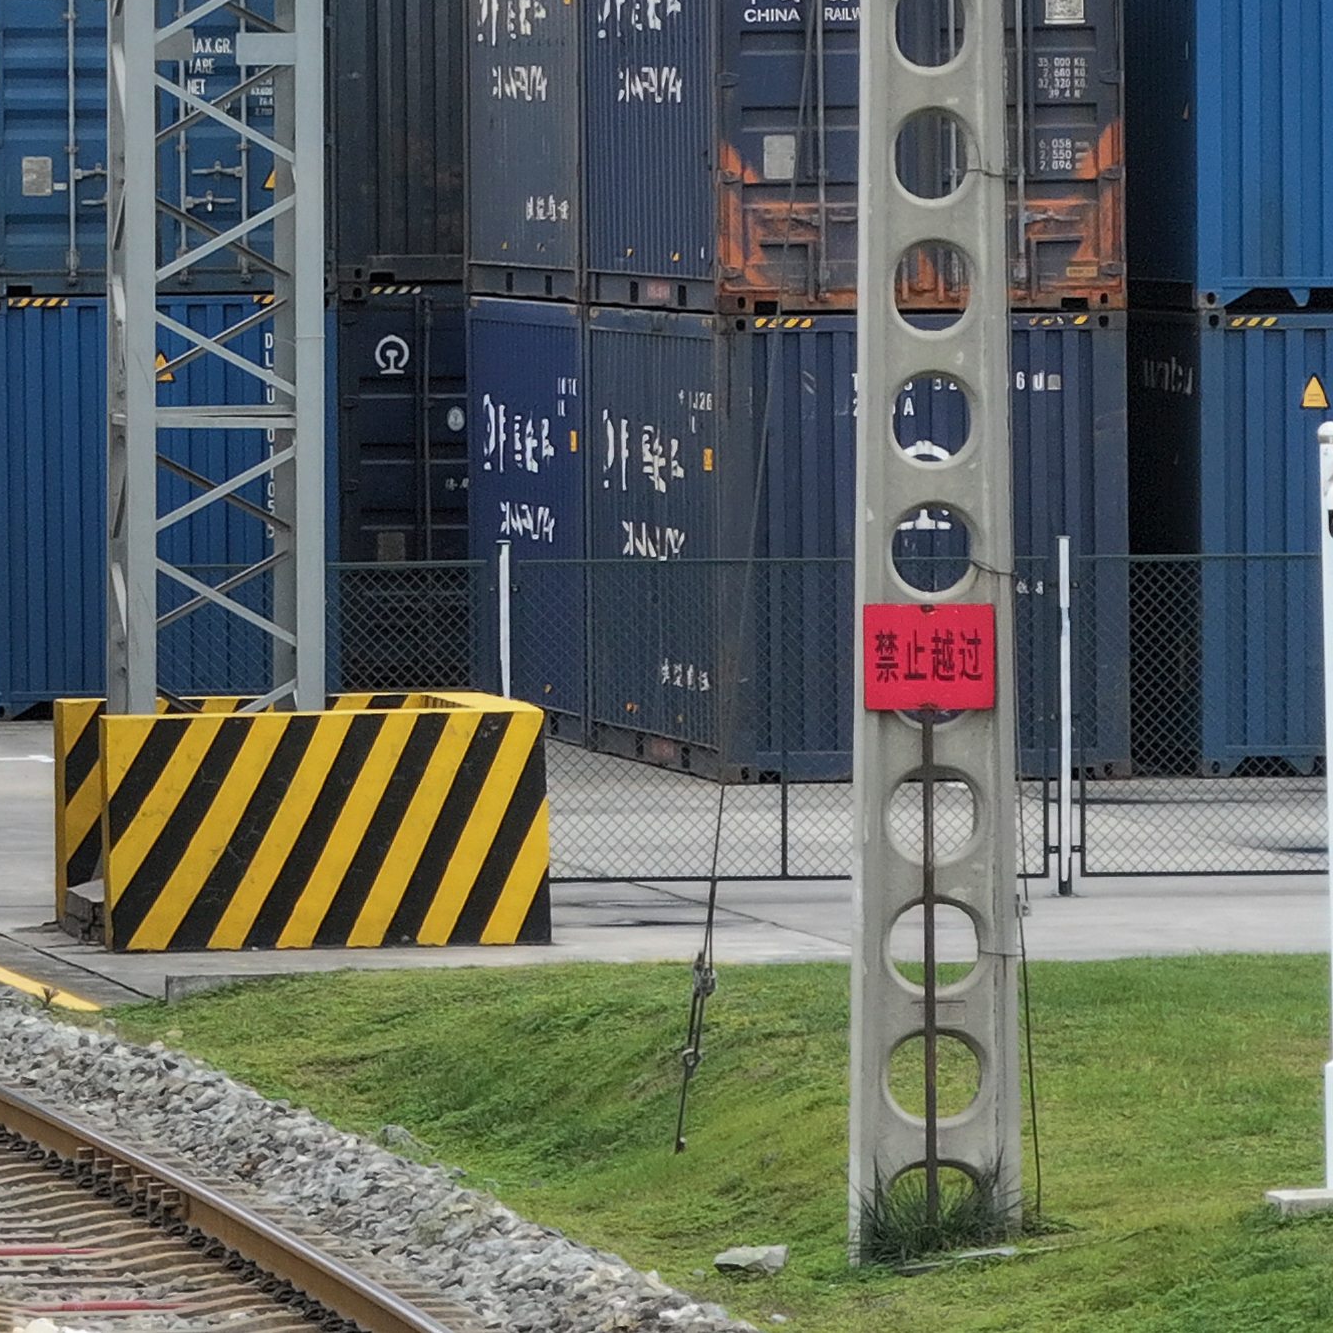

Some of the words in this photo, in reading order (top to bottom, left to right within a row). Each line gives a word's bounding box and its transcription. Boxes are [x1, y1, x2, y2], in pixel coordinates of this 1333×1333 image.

[743, 7, 801, 23] CHINA
[874, 628, 983, 684] 禁止越过
